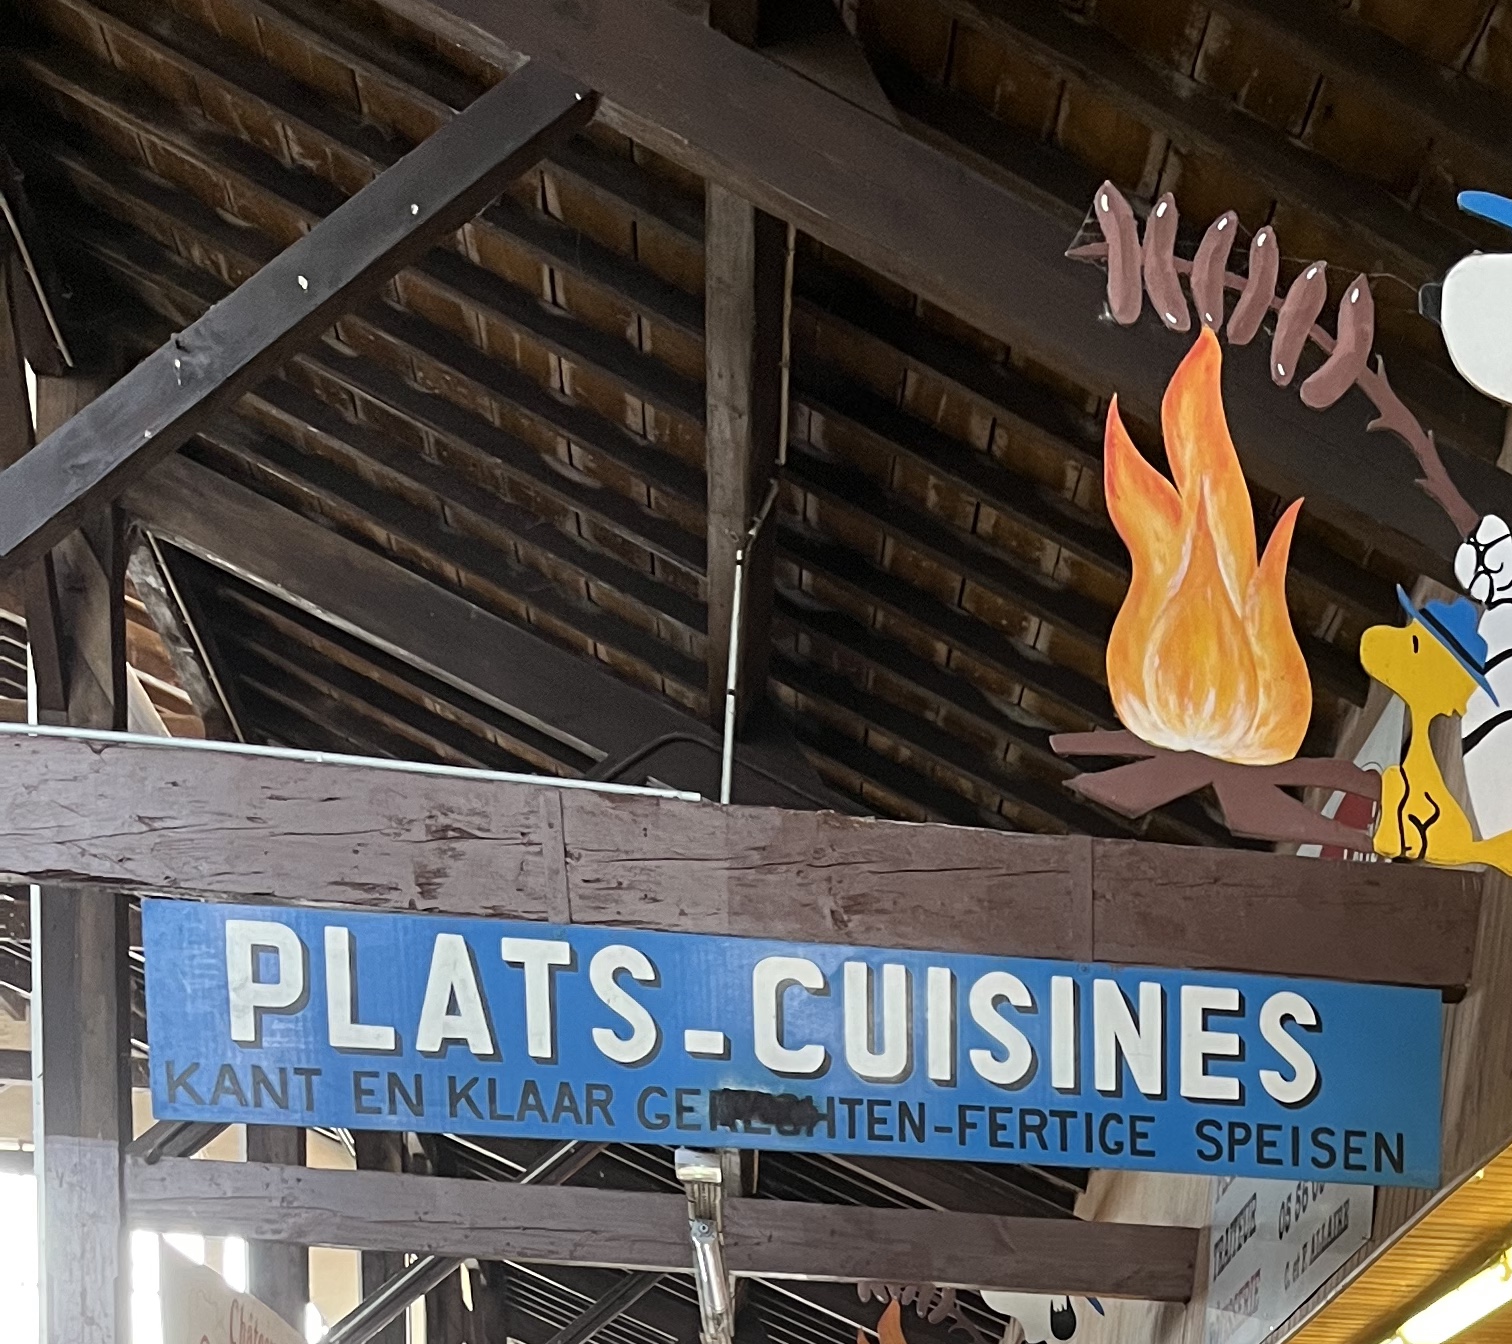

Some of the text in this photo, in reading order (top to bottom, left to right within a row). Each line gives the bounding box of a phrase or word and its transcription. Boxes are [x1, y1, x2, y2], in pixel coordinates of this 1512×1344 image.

[165, 1060, 1405, 1174] KANT EN KLAAR GEHTEN-FERTIGE SPEISEN
